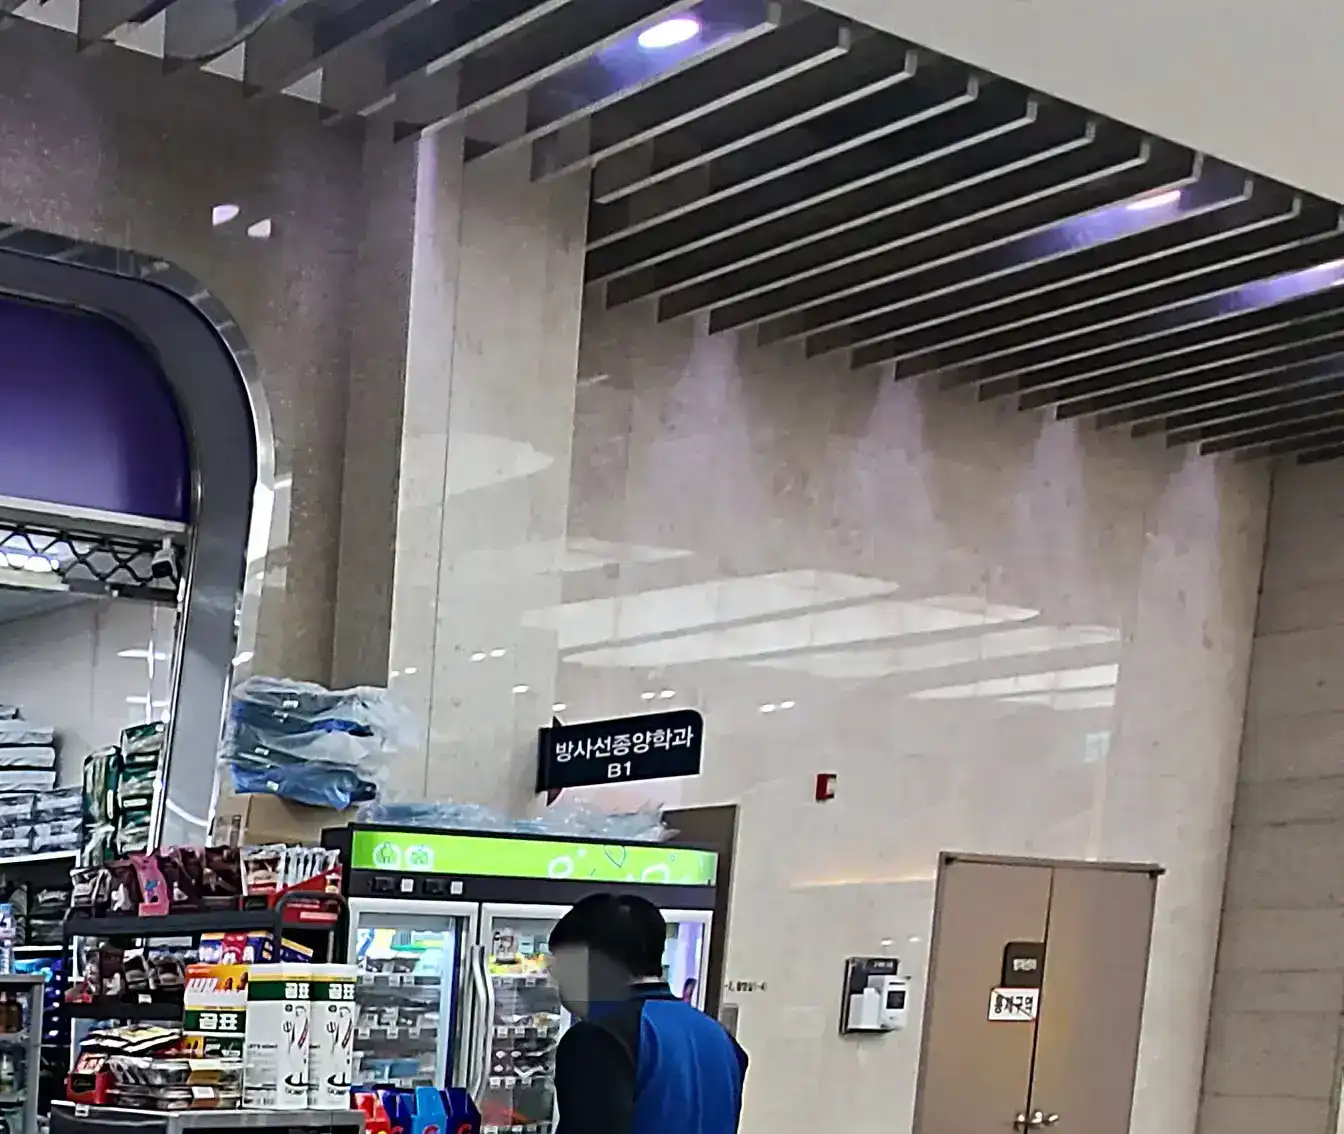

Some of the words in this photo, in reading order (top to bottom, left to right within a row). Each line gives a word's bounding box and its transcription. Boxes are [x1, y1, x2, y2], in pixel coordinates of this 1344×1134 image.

[555, 725, 695, 763] 방사선종양학과
[607, 761, 632, 779] B1
[284, 982, 310, 1000] 곰표
[328, 982, 355, 1000] 곰표
[198, 1012, 238, 1031] 곰표
